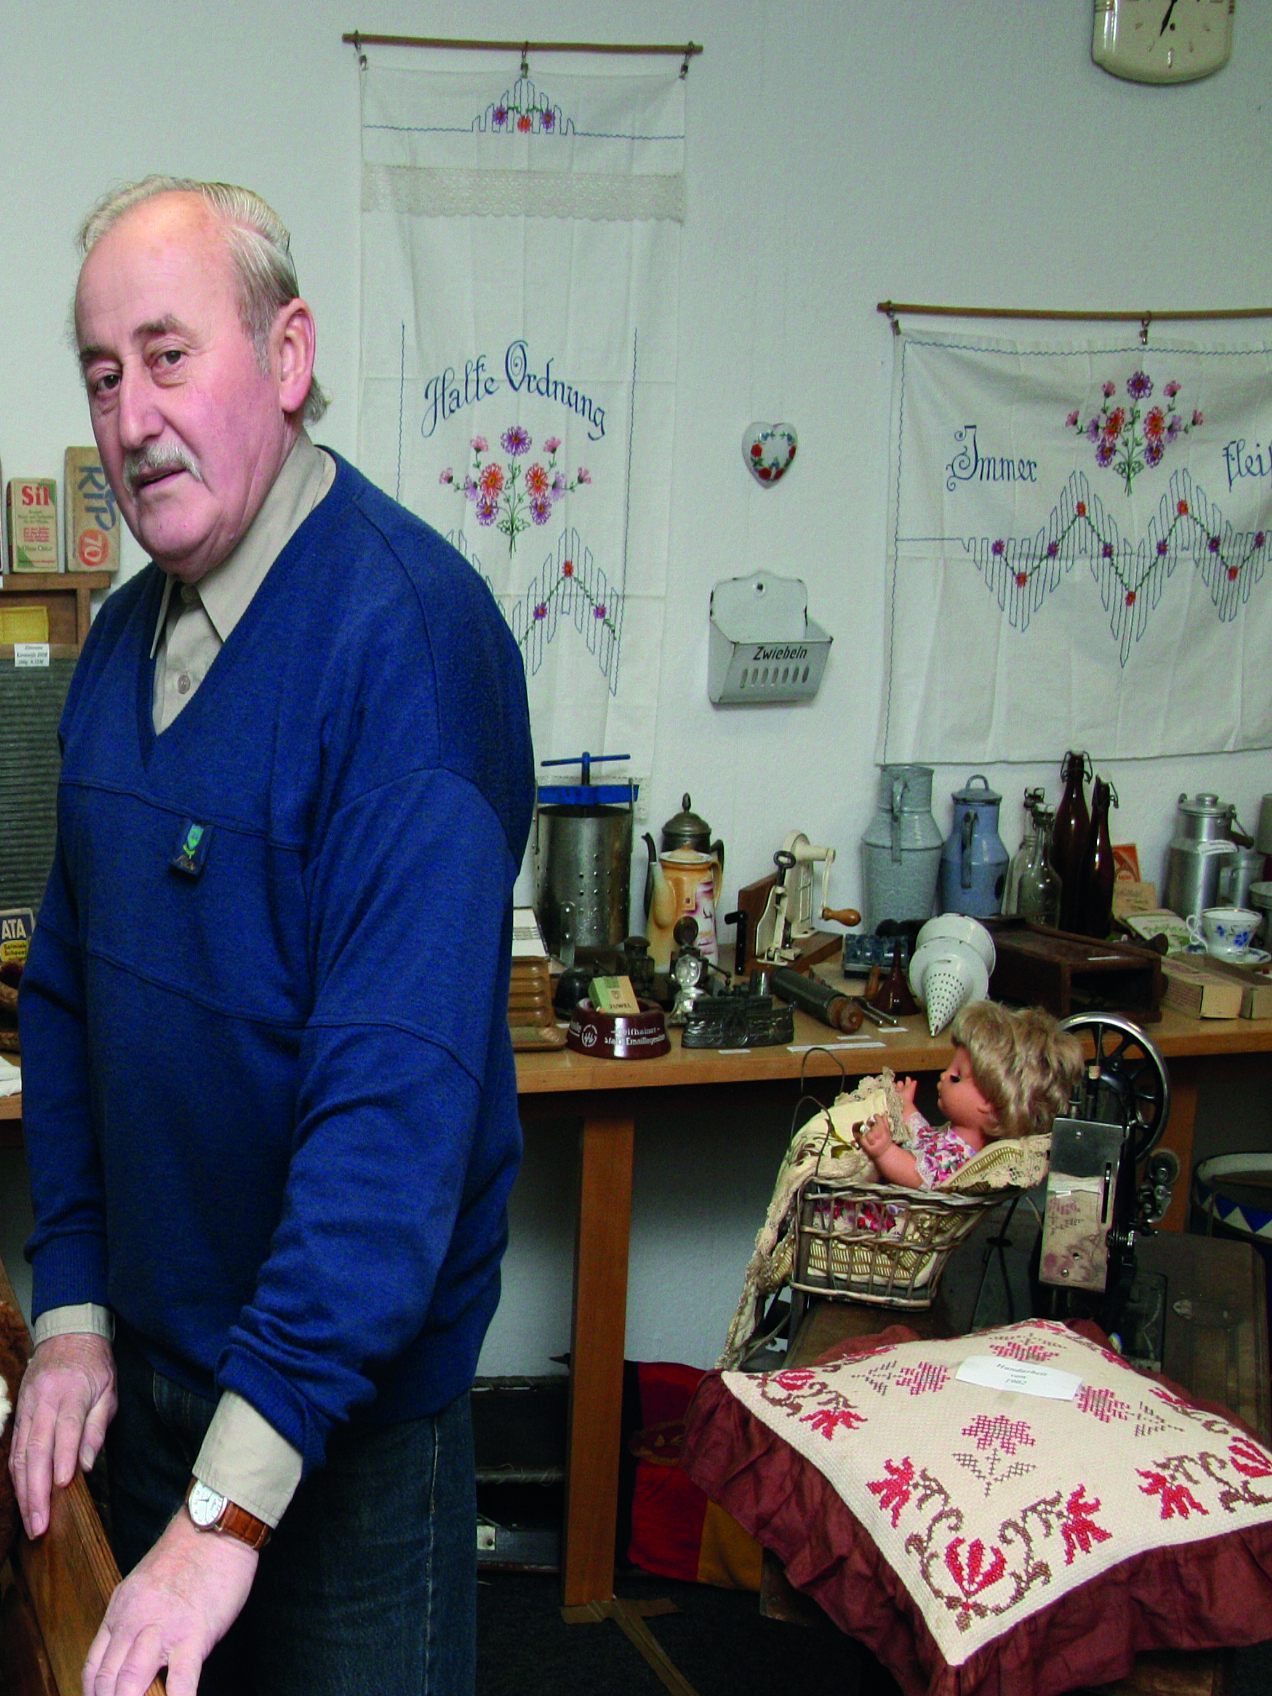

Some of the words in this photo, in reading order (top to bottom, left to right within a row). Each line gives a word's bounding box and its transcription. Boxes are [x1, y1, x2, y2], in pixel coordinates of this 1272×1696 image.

[504, 340, 606, 441] Ordnung
[946, 425, 1037, 492] Immer
[21, 485, 50, 506] Sil
[84, 534, 103, 562] 70
[752, 645, 808, 662] Zwiebeln
[1, 918, 27, 940] ATA
